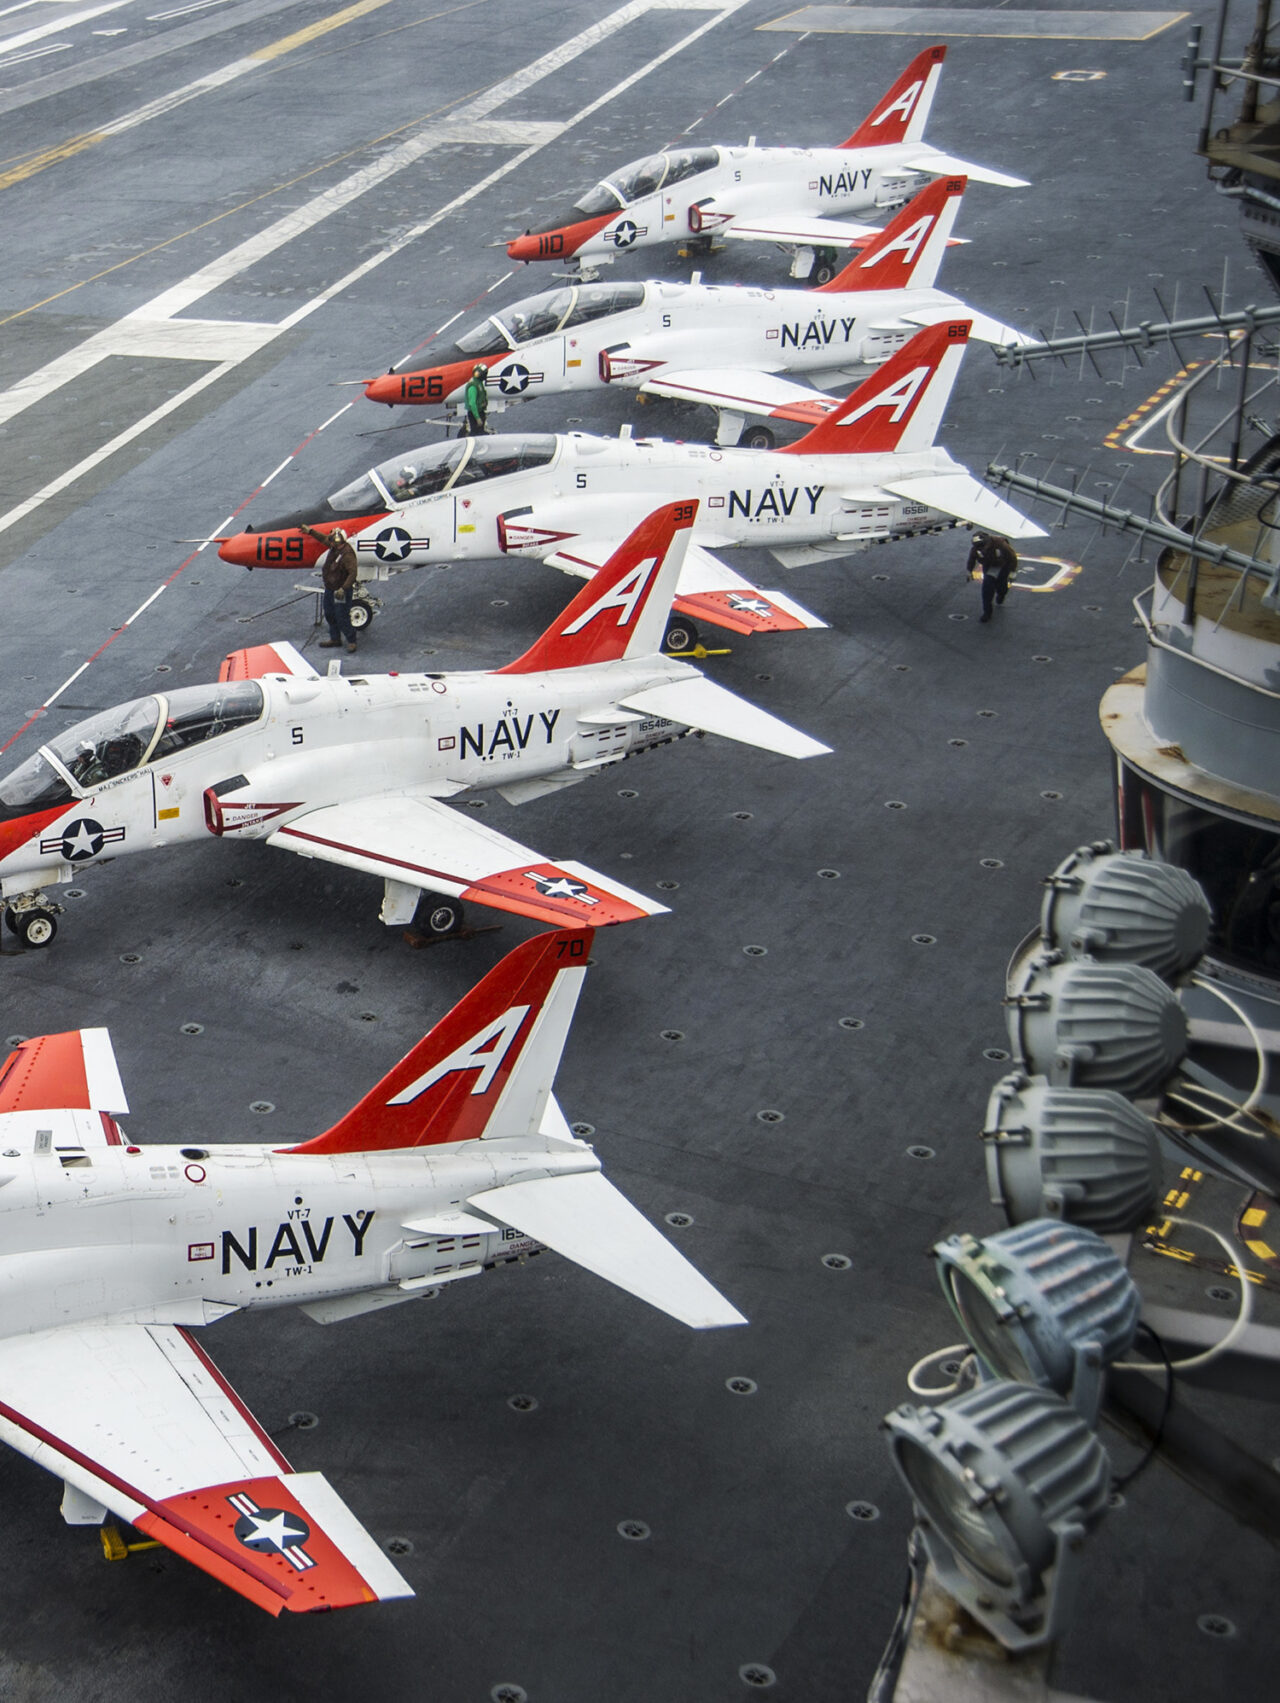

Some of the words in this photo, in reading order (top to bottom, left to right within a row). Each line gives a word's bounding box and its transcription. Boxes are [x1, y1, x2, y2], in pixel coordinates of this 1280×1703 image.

[870, 80, 924, 127] A
[819, 168, 872, 196] NAVY
[946, 181, 962, 192] 26
[539, 234, 564, 255] 110
[860, 214, 935, 269] A
[781, 317, 856, 348] NAVY
[948, 325, 967, 337] 69
[401, 376, 443, 398] 126
[835, 366, 931, 426] A
[673, 506, 693, 521] 39
[728, 486, 825, 518] NAVY
[257, 536, 303, 561] 169
[560, 557, 659, 637] A
[502, 709, 518, 718] VT-7
[460, 709, 561, 760] NAVY
[502, 752, 521, 760] TW-1
[232, 812, 259, 821] DANGER
[556, 939, 584, 959] 70
[385, 1004, 533, 1107] A
[287, 1208, 311, 1220] VT-7
[222, 1210, 376, 1275] NAVY
[285, 1265, 313, 1277] TW-1
